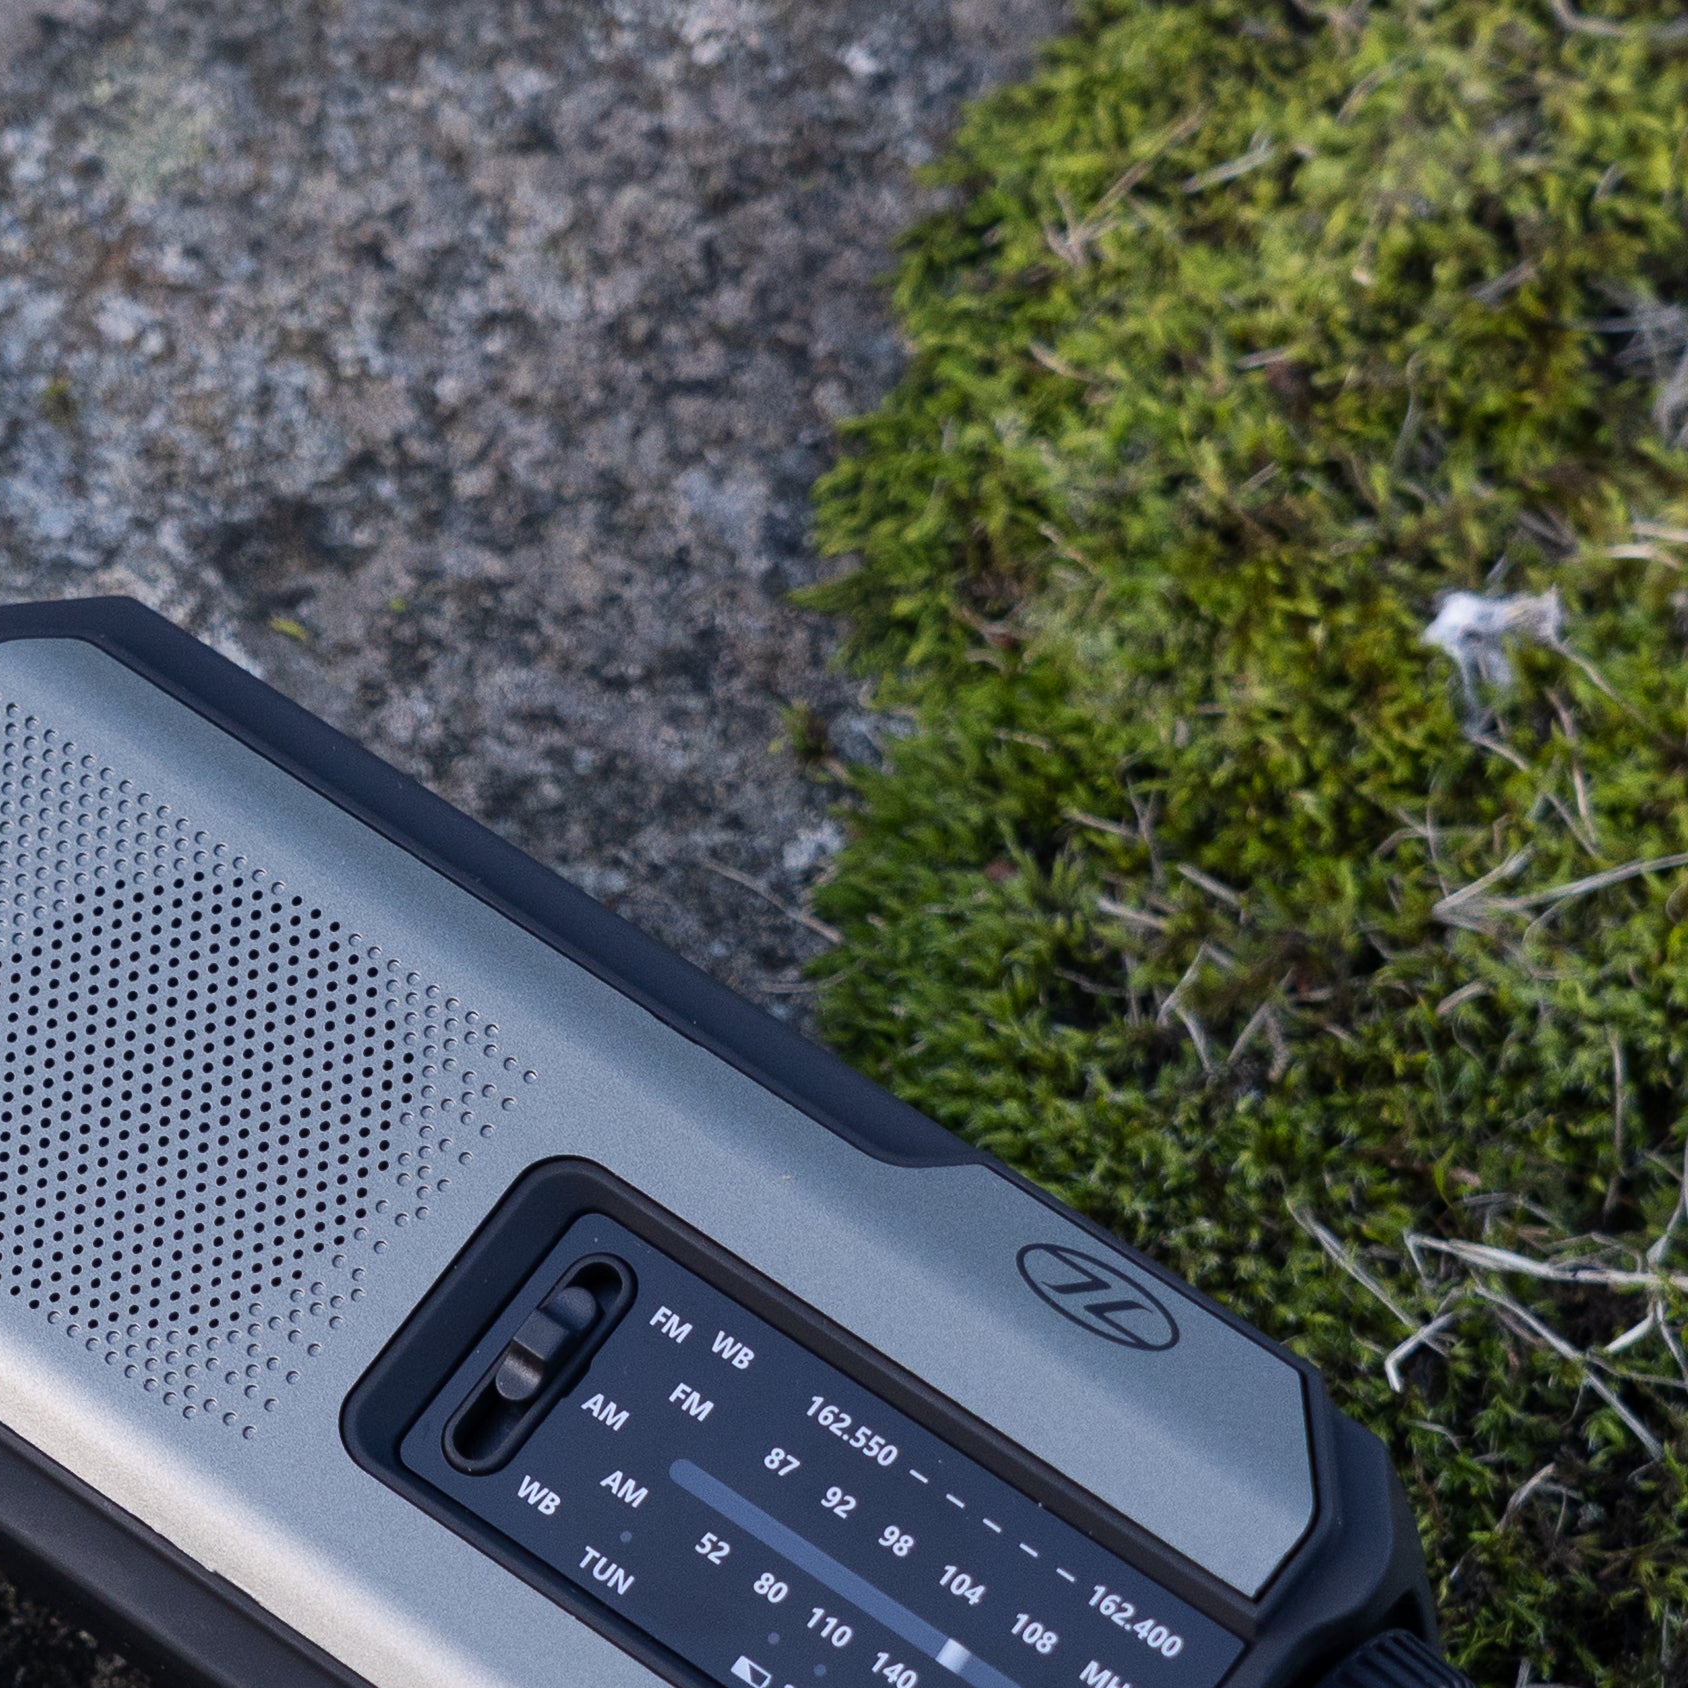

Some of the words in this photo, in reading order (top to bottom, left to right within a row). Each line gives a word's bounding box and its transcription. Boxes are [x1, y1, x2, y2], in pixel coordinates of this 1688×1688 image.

[649, 1305, 693, 1344] FM
[580, 1393, 630, 1432] AM
[517, 1474, 561, 1516] WB
[668, 1382, 715, 1422] FM
[763, 1447, 801, 1477] 87
[820, 1486, 857, 1519] 92
[878, 1525, 914, 1557] 98
[939, 1565, 986, 1606] 104
[1011, 1613, 1058, 1654] 108
[711, 1330, 755, 1370] WB
[806, 1395, 898, 1466] 162.550
[1088, 1585, 1183, 1658] 162.400
[579, 1545, 635, 1595] TUN
[599, 1470, 649, 1508] AM
[694, 1532, 731, 1565] 52
[753, 1572, 789, 1604] 80
[807, 1607, 853, 1648] 110
